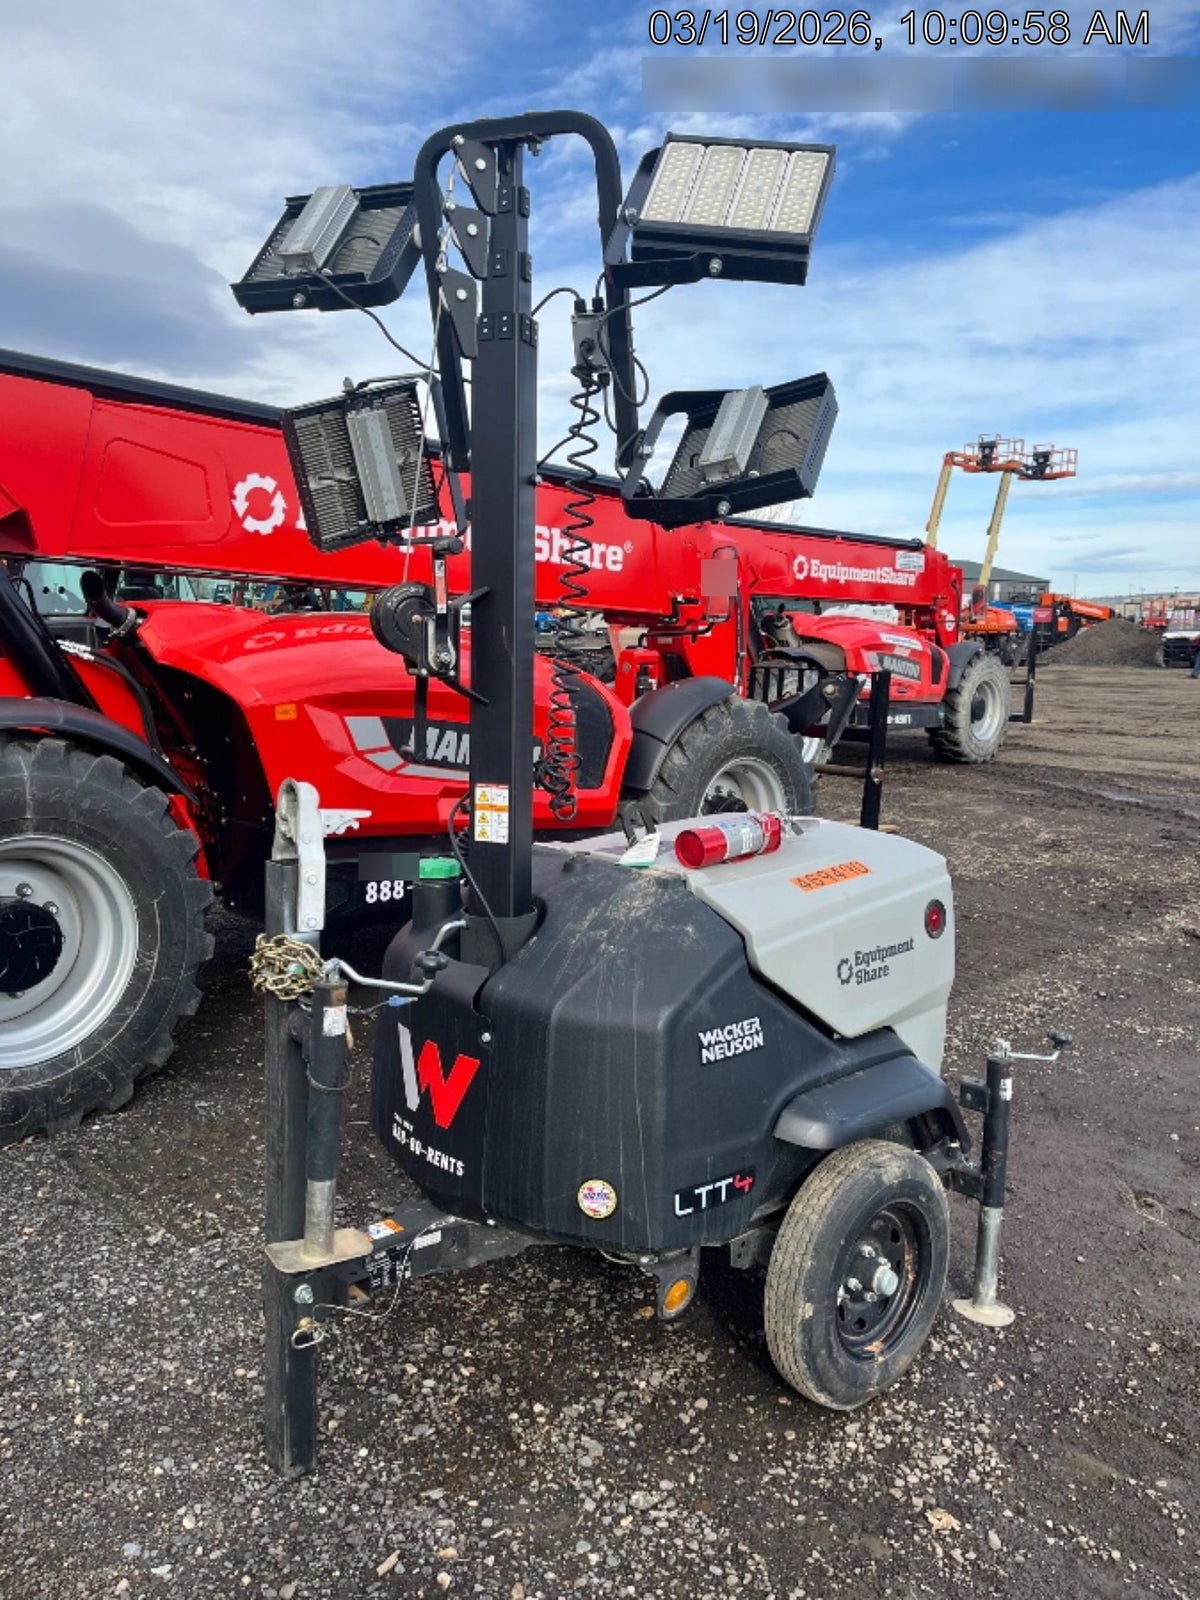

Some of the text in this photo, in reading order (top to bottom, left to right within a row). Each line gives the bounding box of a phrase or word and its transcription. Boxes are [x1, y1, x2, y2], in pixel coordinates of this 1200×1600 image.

[854, 936, 915, 967] Equipment
[855, 964, 890, 985] Share
[698, 1016, 762, 1047] WACKER
[701, 1031, 764, 1064] NEUSON
[674, 1174, 754, 1217] LTT4
